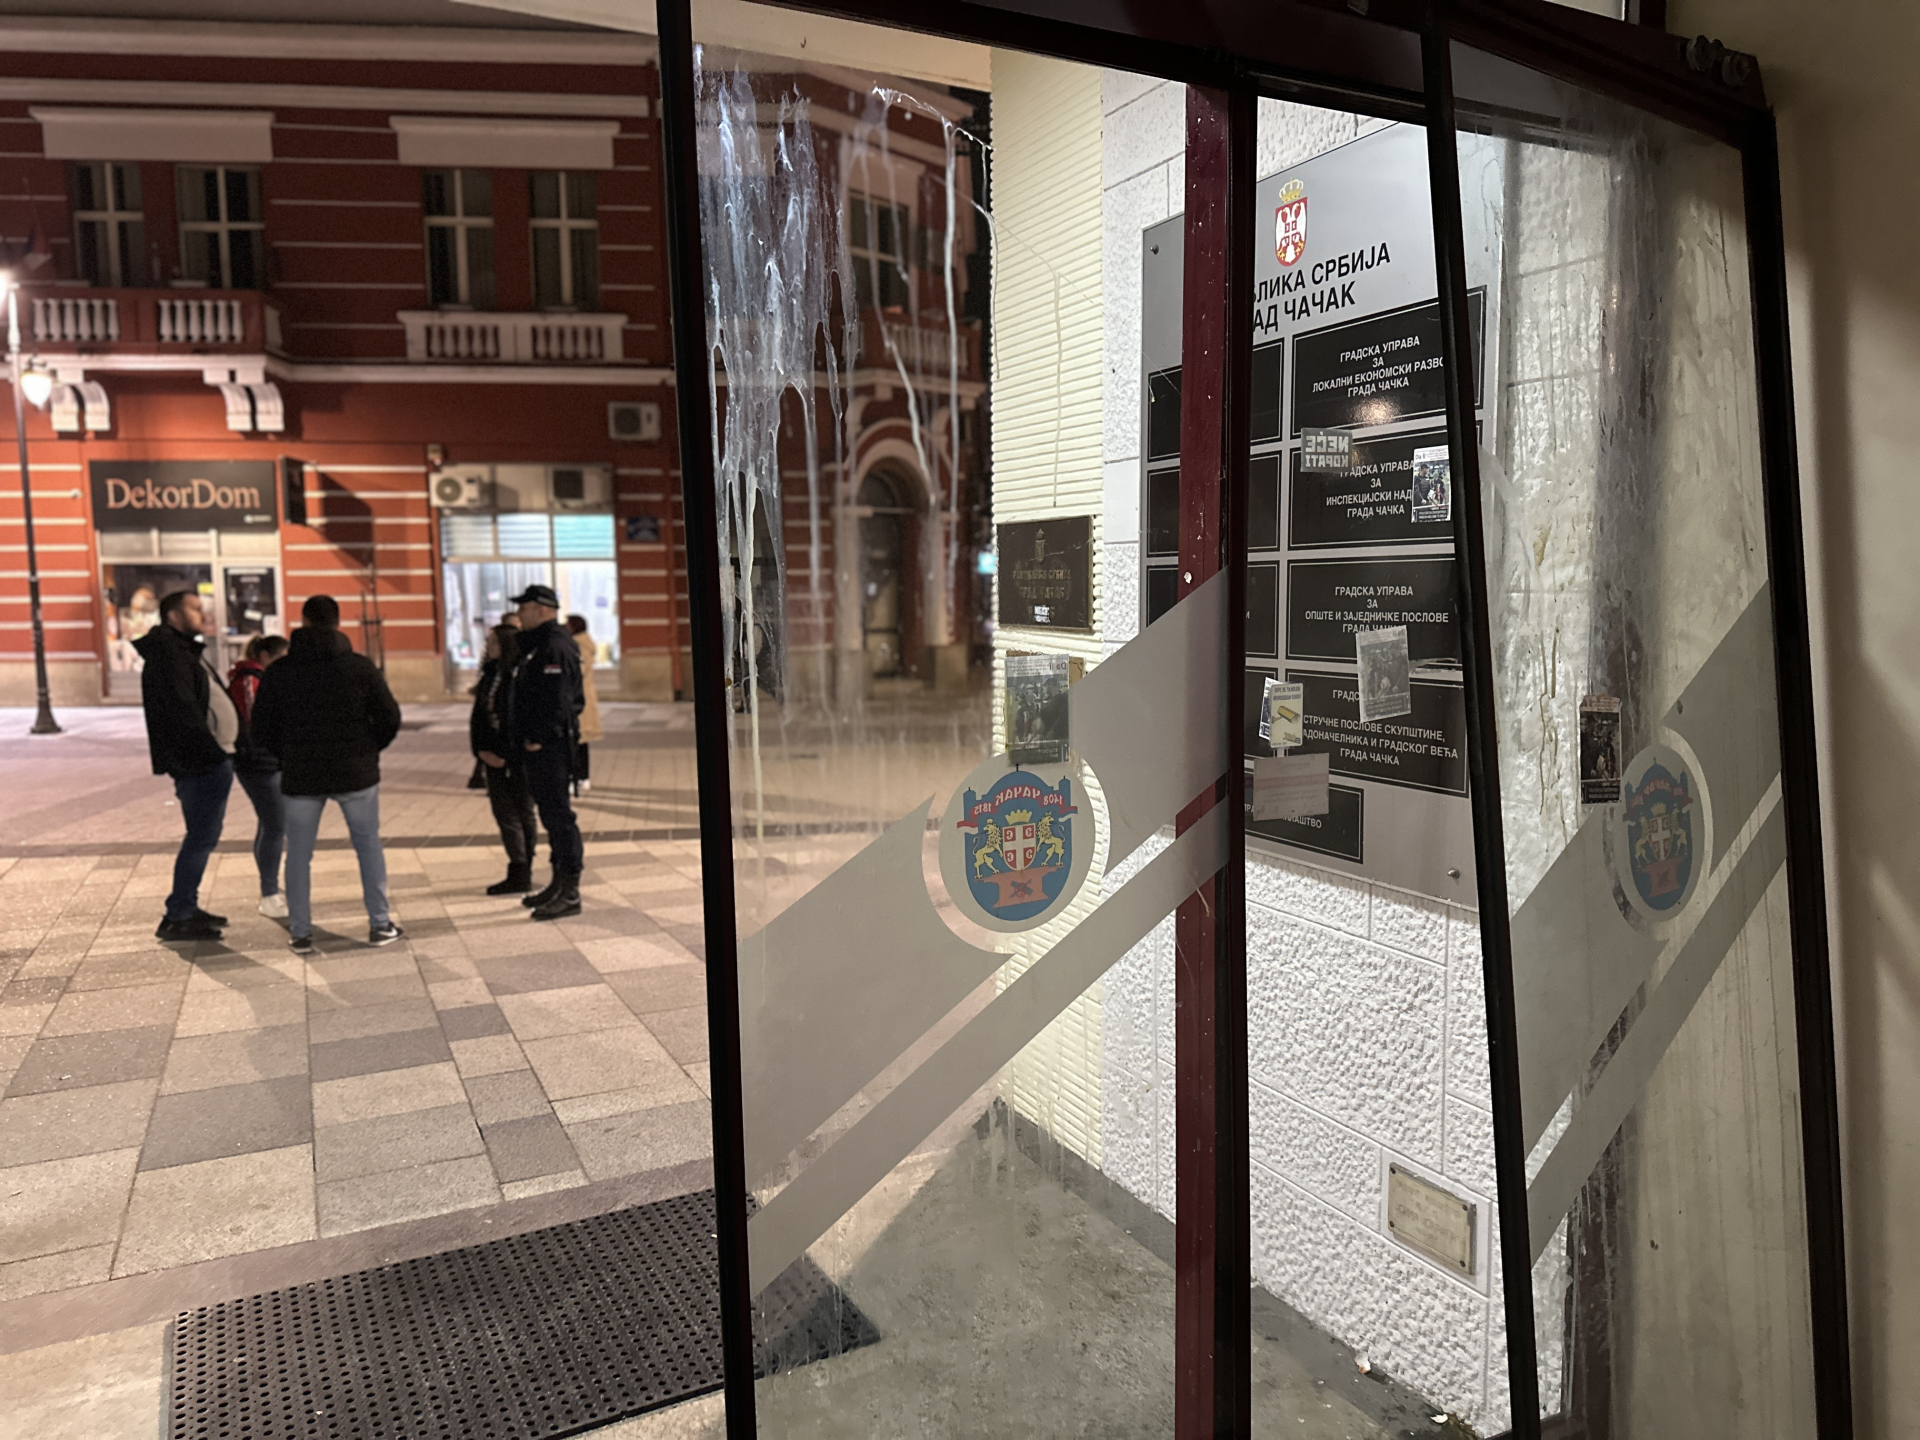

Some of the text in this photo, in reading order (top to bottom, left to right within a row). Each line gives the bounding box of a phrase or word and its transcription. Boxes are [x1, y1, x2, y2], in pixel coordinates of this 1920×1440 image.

[1254, 242, 1391, 303] ЛИКА СРБИЈА
[1253, 280, 1356, 335] АД ЧАЧАК
[1340, 335, 1420, 362] ГРАДСКА УПРАВА
[1372, 356, 1384, 368] ЗА
[1312, 375, 1353, 393] ЛОКАЛНИ
[1354, 363, 1412, 384] ЕКОНОМСКИ
[1347, 376, 1409, 397] ГРАДА ЧАЧКА
[1380, 461, 1414, 472] УПРАВА
[1370, 478, 1382, 488] ЗА
[105, 478, 261, 510] DekorDom
[1326, 489, 1413, 506] ИНСПЕКЦИЈСКИ НАД
[1347, 506, 1374, 519] ГРАДА
[1376, 504, 1405, 516] ЧАЧКА
[1334, 586, 1413, 598] ГРАДСКА УПРАВА
[1366, 598, 1378, 609] ЗА
[1305, 611, 1449, 623] ОПШТЕ И ЗАЈЕДНИЧКЕ ПОСЛОВЕ
[1332, 689, 1360, 702] ГРАДС
[1303, 714, 1446, 743] СТРУЧНЕ ПОСЛОВЕ СКУПШТИНЕ,
[1303, 730, 1459, 759] АДОНАЧЕЛНИКА И ГРАДСКОГ ВЕЋА
[1340, 748, 1400, 766] ГРАДА ЧАЧКА
